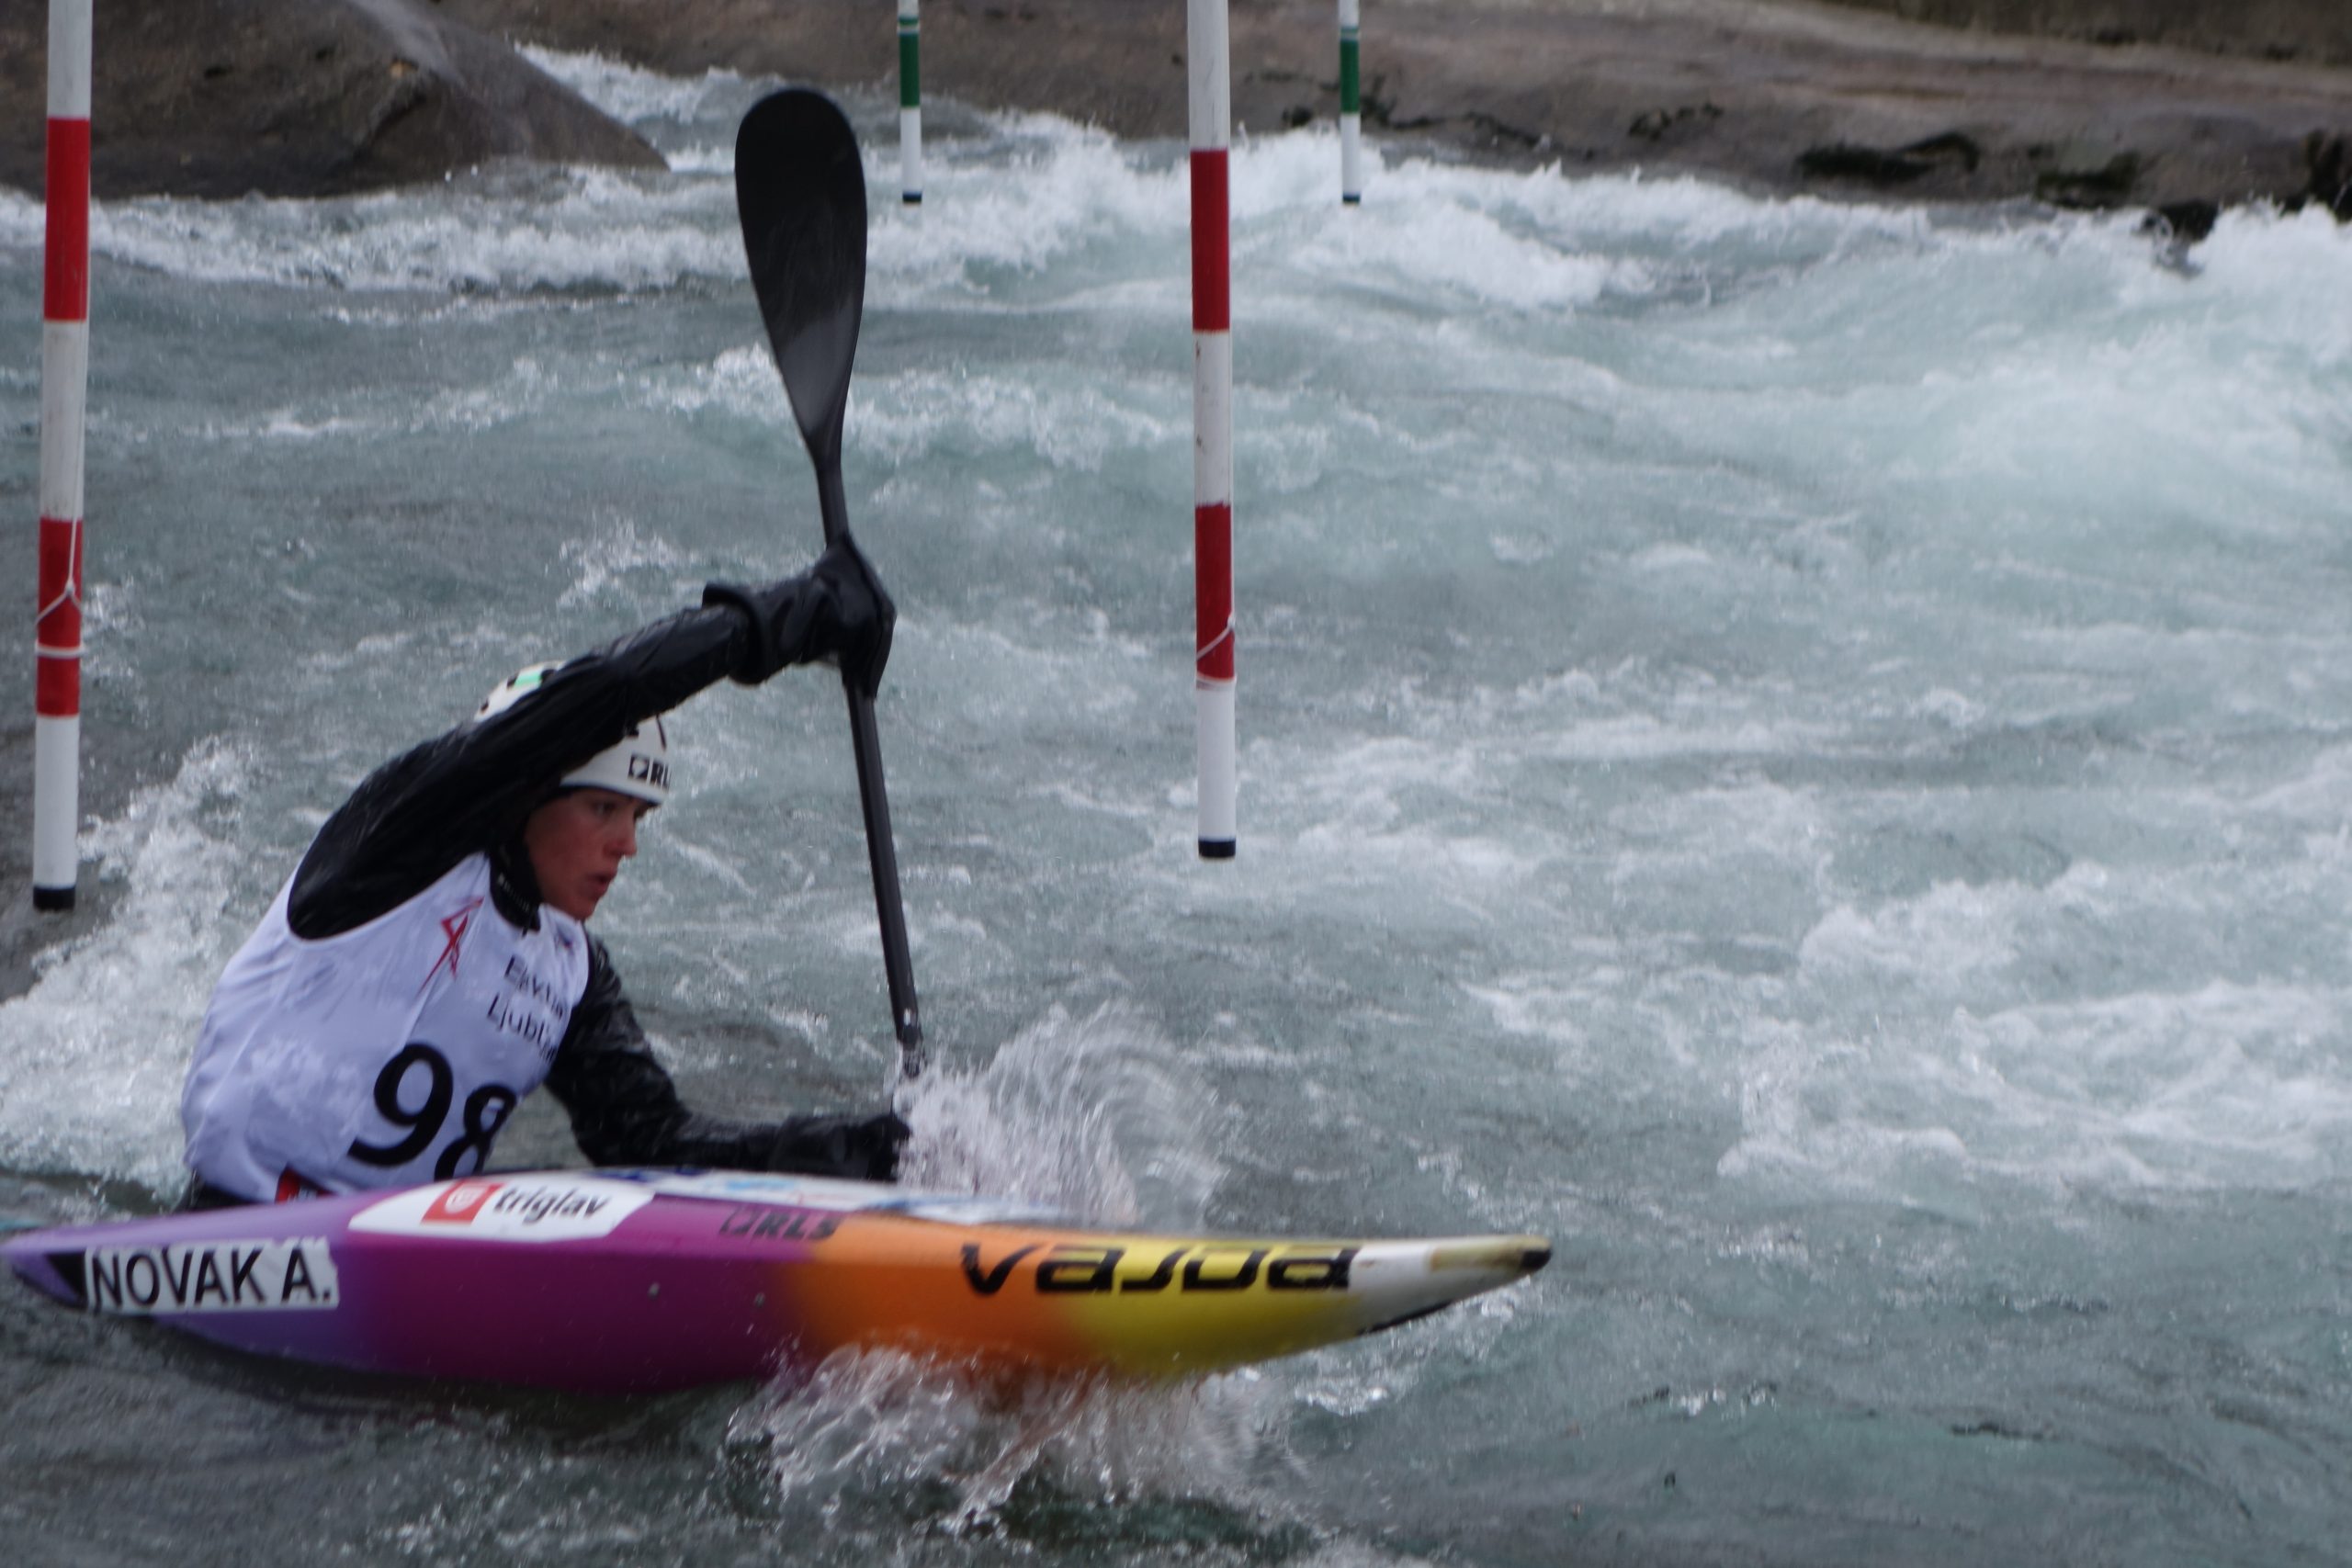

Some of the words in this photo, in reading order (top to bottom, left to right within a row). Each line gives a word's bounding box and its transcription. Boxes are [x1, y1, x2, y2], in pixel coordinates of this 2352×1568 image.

[346, 1042, 517, 1181] 98
[492, 1186, 611, 1224] triglav
[92, 1245, 266, 1311] NOVAK
[281, 1243, 332, 1303] A.
